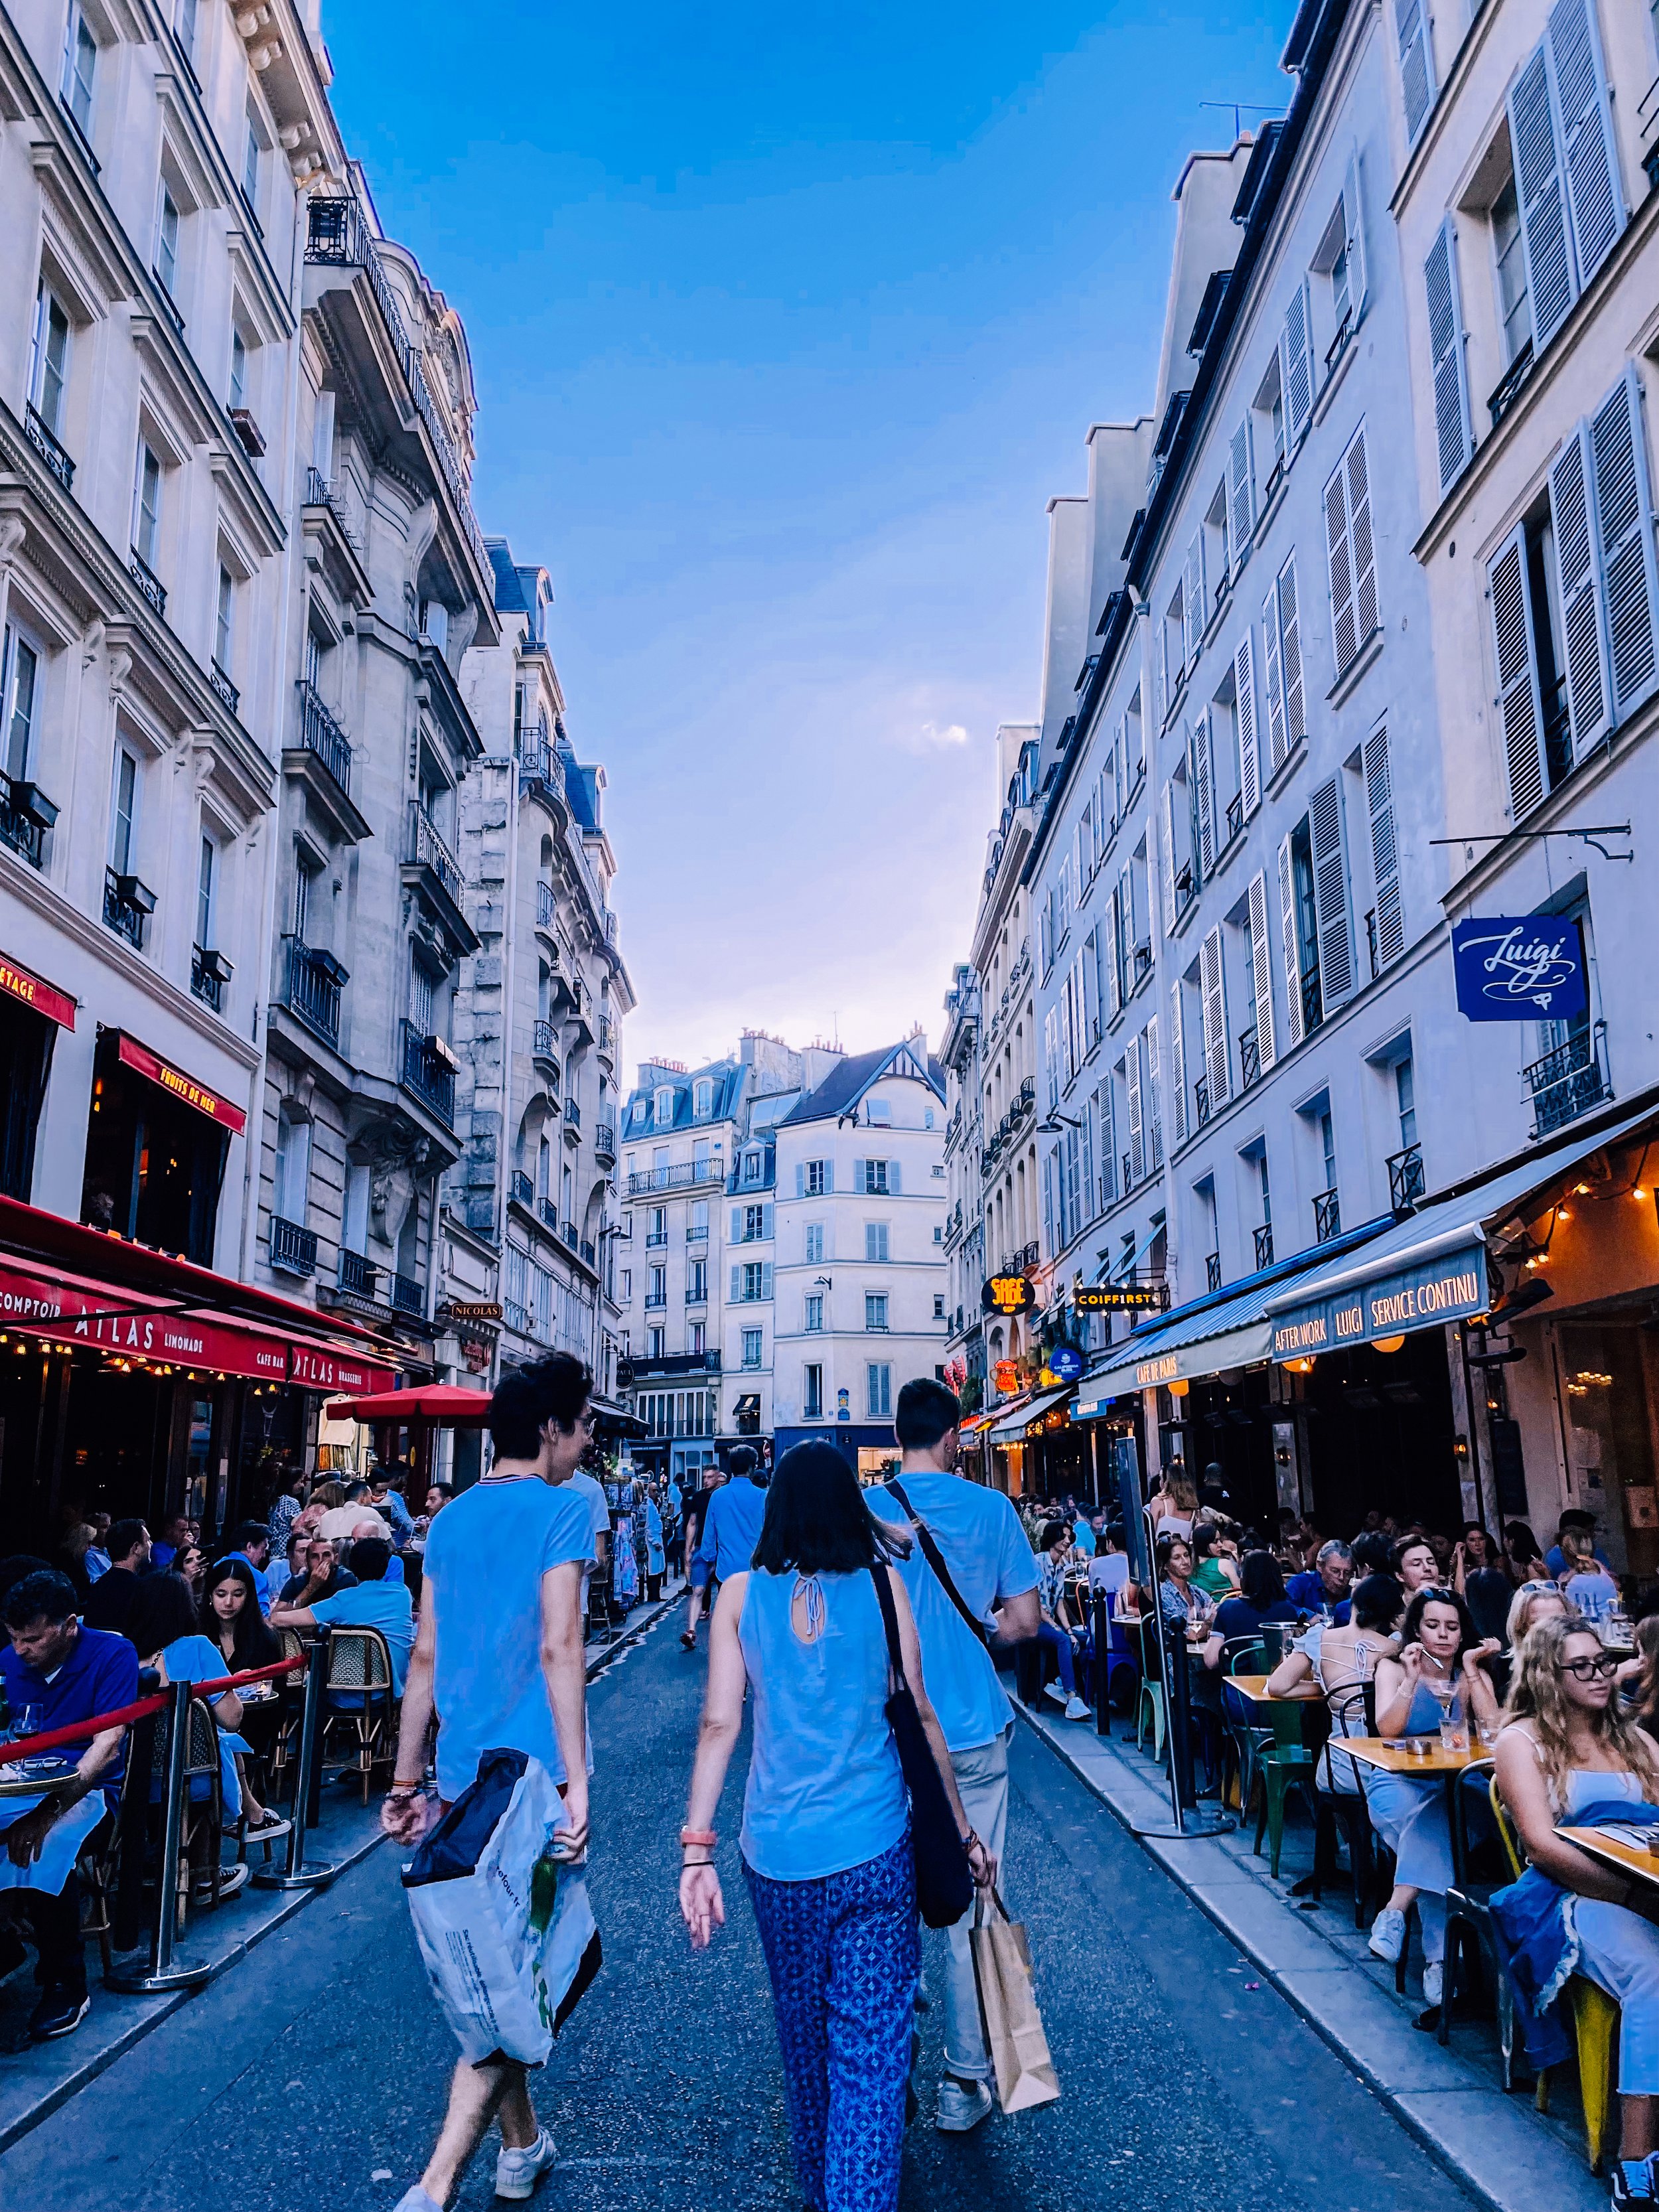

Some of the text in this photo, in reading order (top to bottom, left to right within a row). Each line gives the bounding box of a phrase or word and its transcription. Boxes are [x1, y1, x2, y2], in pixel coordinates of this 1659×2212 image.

[1459, 926, 1575, 995] Luigi
[160, 1068, 215, 1114] FRUITS DE MER
[455, 1307, 498, 1315] NICOLAS
[1078, 1294, 1151, 1305] COIFF1RST
[1275, 1272, 1478, 1351] AFTER WORK LUIGI SERVICE CONTINU
[0, 1291, 284, 1368] OMPTOIR ATLAS LIMONADE CAFE BAR
[293, 1355, 362, 1385] ATLAS BRASSERIE
[1137, 1356, 1177, 1384] CAFE DE PARIS
